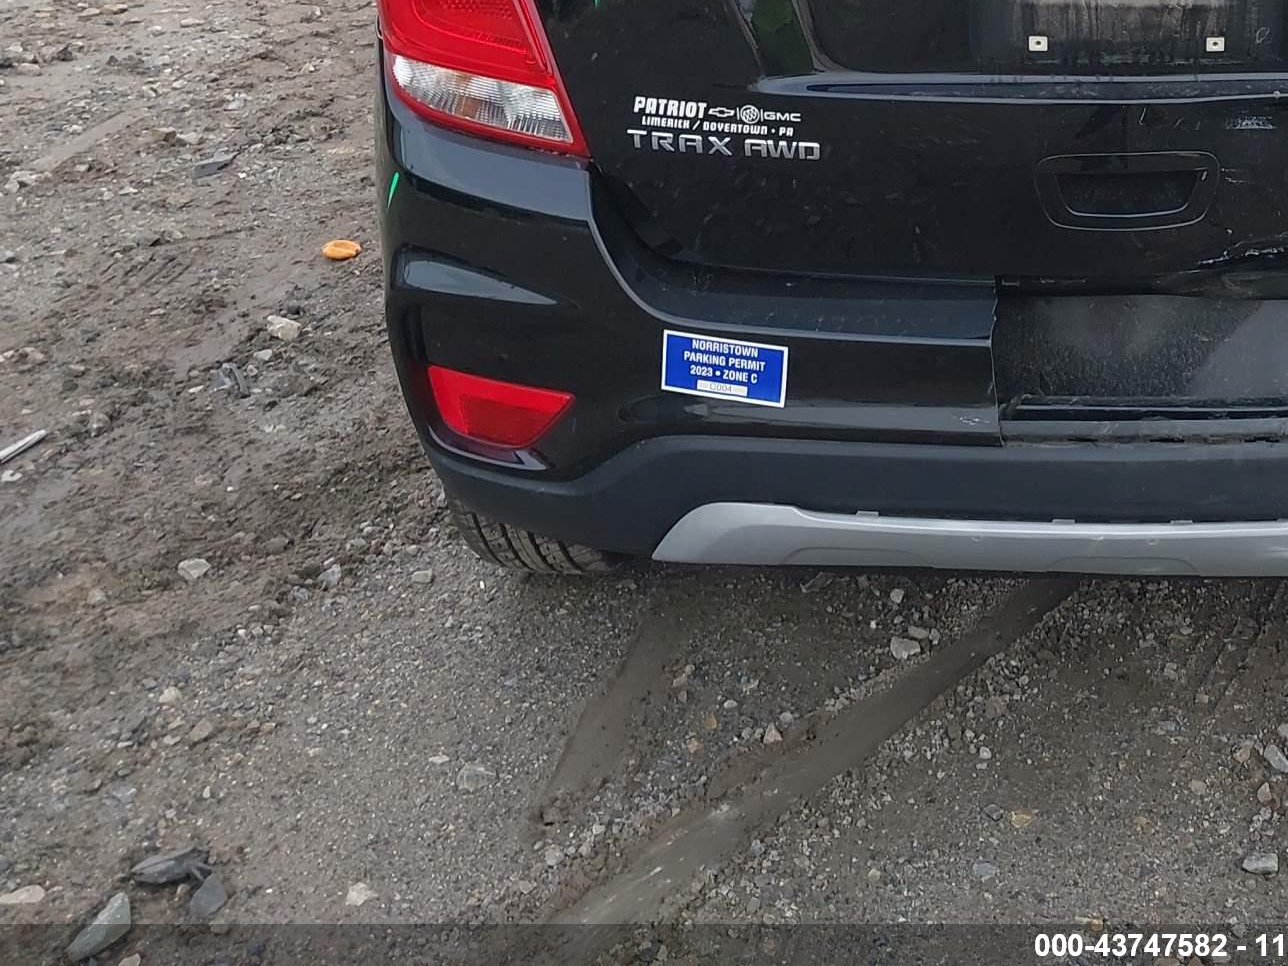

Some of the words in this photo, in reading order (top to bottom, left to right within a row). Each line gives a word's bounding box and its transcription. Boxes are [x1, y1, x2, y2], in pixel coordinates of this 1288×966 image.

[633, 96, 707, 119] PATRIOT
[763, 111, 802, 122] GMC
[641, 116, 690, 130] LIMERICK
[778, 127, 794, 137] PA
[627, 129, 733, 156] TRAX
[744, 138, 821, 160] AWD
[691, 338, 759, 358] NORRISTOWN
[683, 350, 726, 367] PARKING
[728, 357, 766, 372] PERMIT
[689, 364, 713, 377] 2023
[722, 369, 749, 383] ZONE
[750, 373, 758, 384] C
